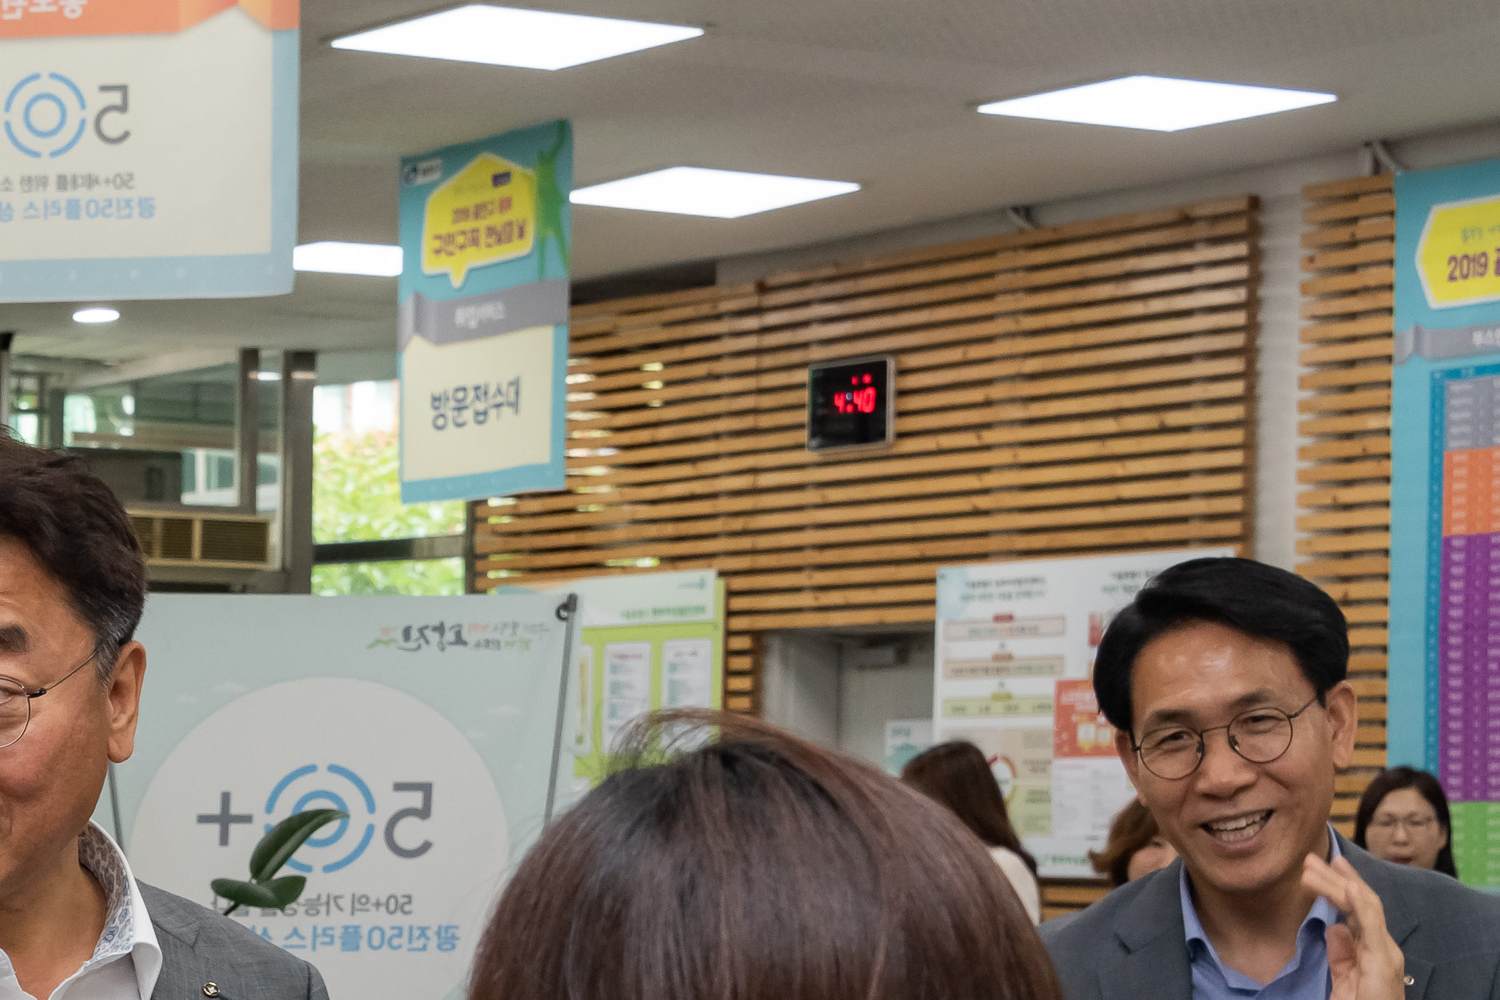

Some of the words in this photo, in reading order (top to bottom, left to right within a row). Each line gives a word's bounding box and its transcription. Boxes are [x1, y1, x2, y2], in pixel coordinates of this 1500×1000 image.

[1447, 251, 1488, 282] 2019
[431, 376, 520, 431] 방문접수대
[834, 386, 876, 414] 4:40
